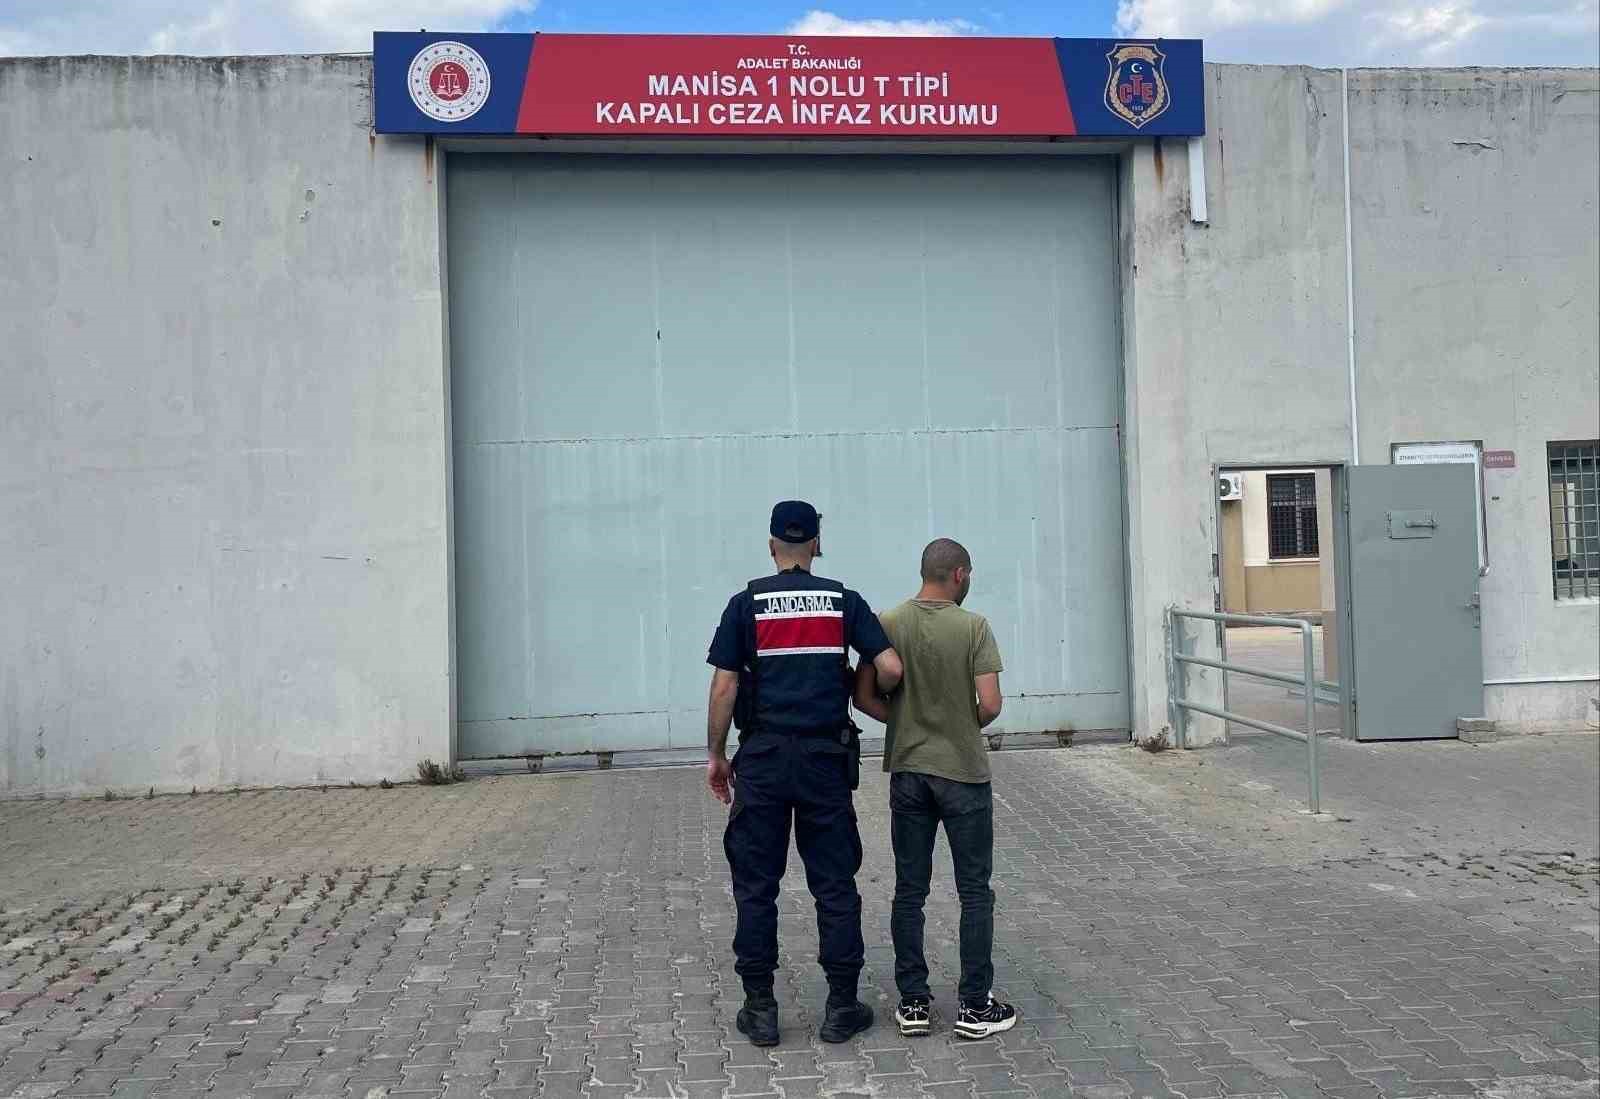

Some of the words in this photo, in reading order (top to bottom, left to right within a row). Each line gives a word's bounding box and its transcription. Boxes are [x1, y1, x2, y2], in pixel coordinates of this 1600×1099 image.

[787, 44, 811, 56] T.C.
[736, 57, 789, 69] ADALET
[791, 56, 861, 70] BAKANLIĞI
[648, 71, 758, 97] MANİSA
[767, 75, 778, 97] 1
[789, 75, 865, 97] NOLU
[873, 76, 890, 97] T
[897, 72, 949, 97] TİPİ
[596, 102, 699, 124] KAPALI
[708, 103, 784, 125] CEZA
[792, 98, 872, 125] İNFAZ
[880, 103, 998, 126] KURUMU
[764, 595, 834, 613] JANDARMA
